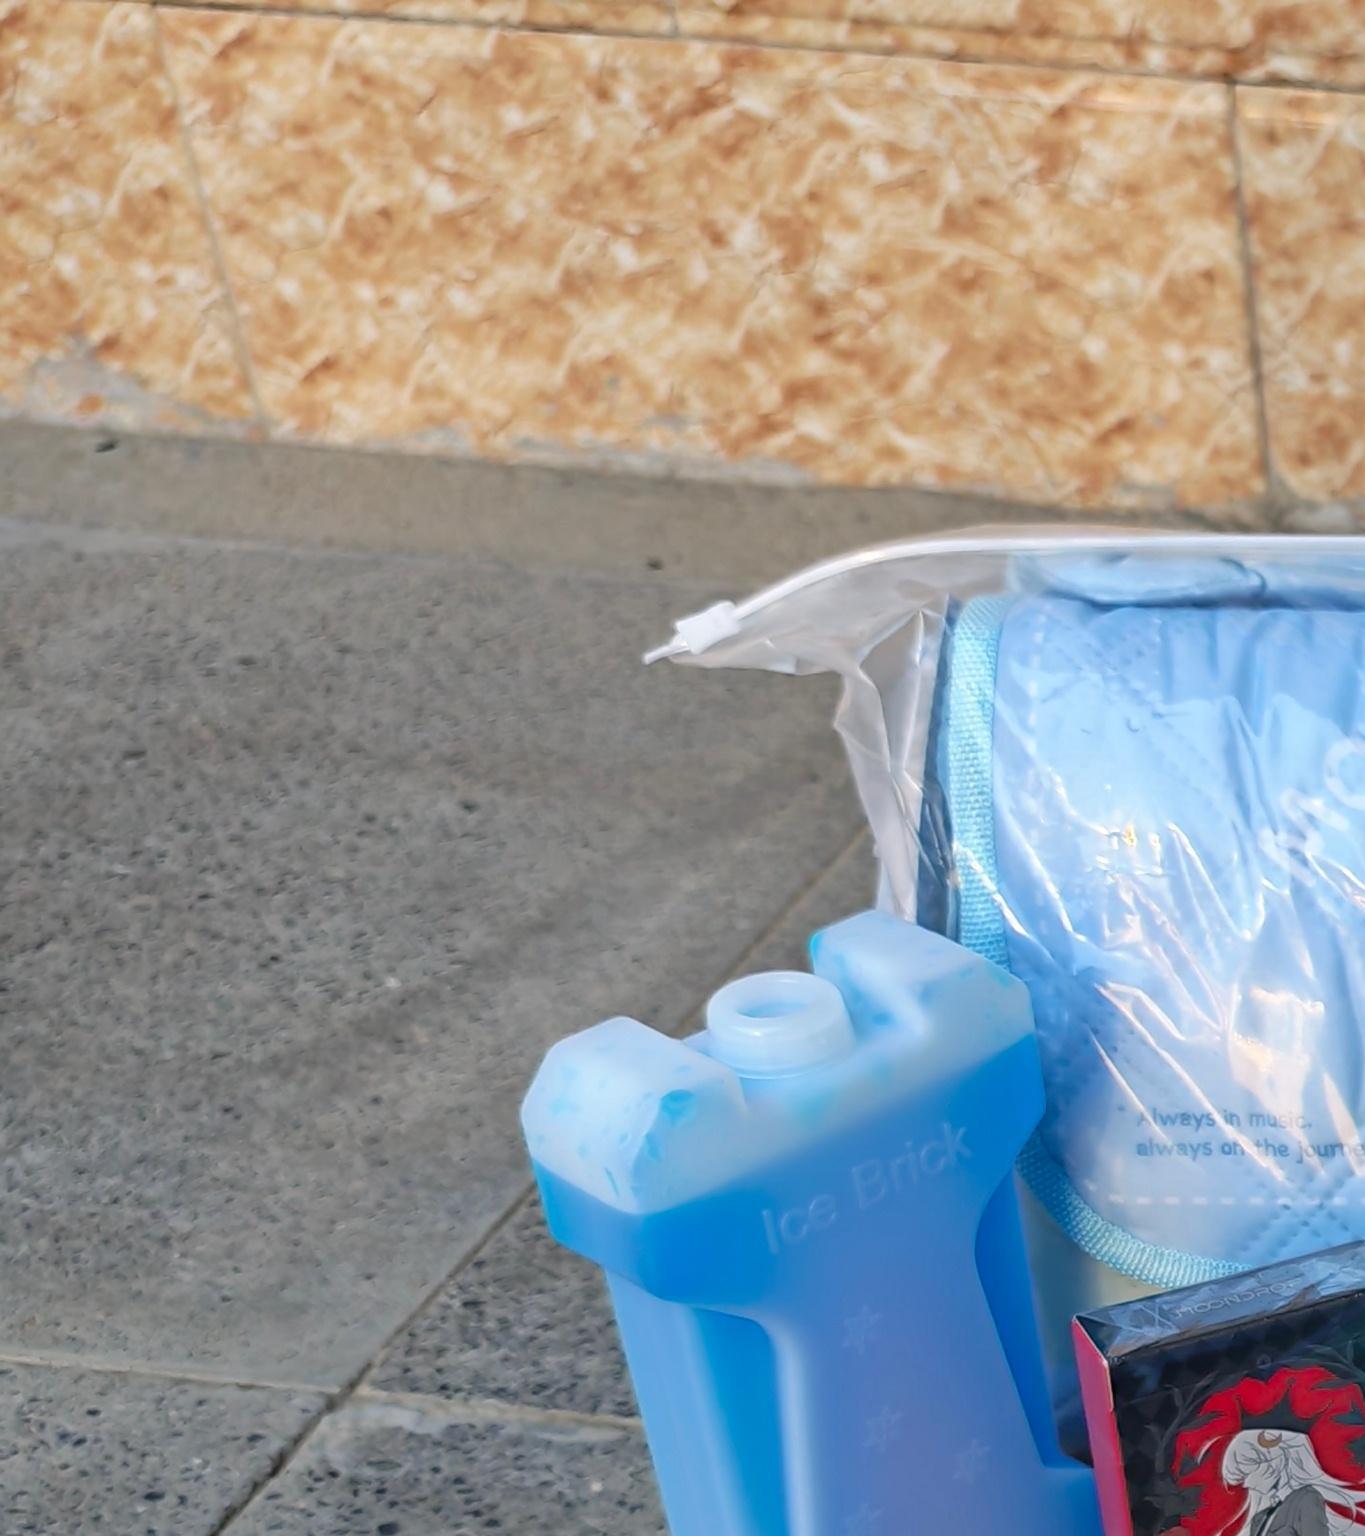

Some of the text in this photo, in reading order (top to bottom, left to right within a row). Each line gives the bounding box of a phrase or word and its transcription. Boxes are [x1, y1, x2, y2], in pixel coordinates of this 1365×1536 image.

[761, 1121, 973, 1255] Ice Brick
[1136, 1139, 1213, 1161] always
[1251, 1139, 1290, 1157] the
